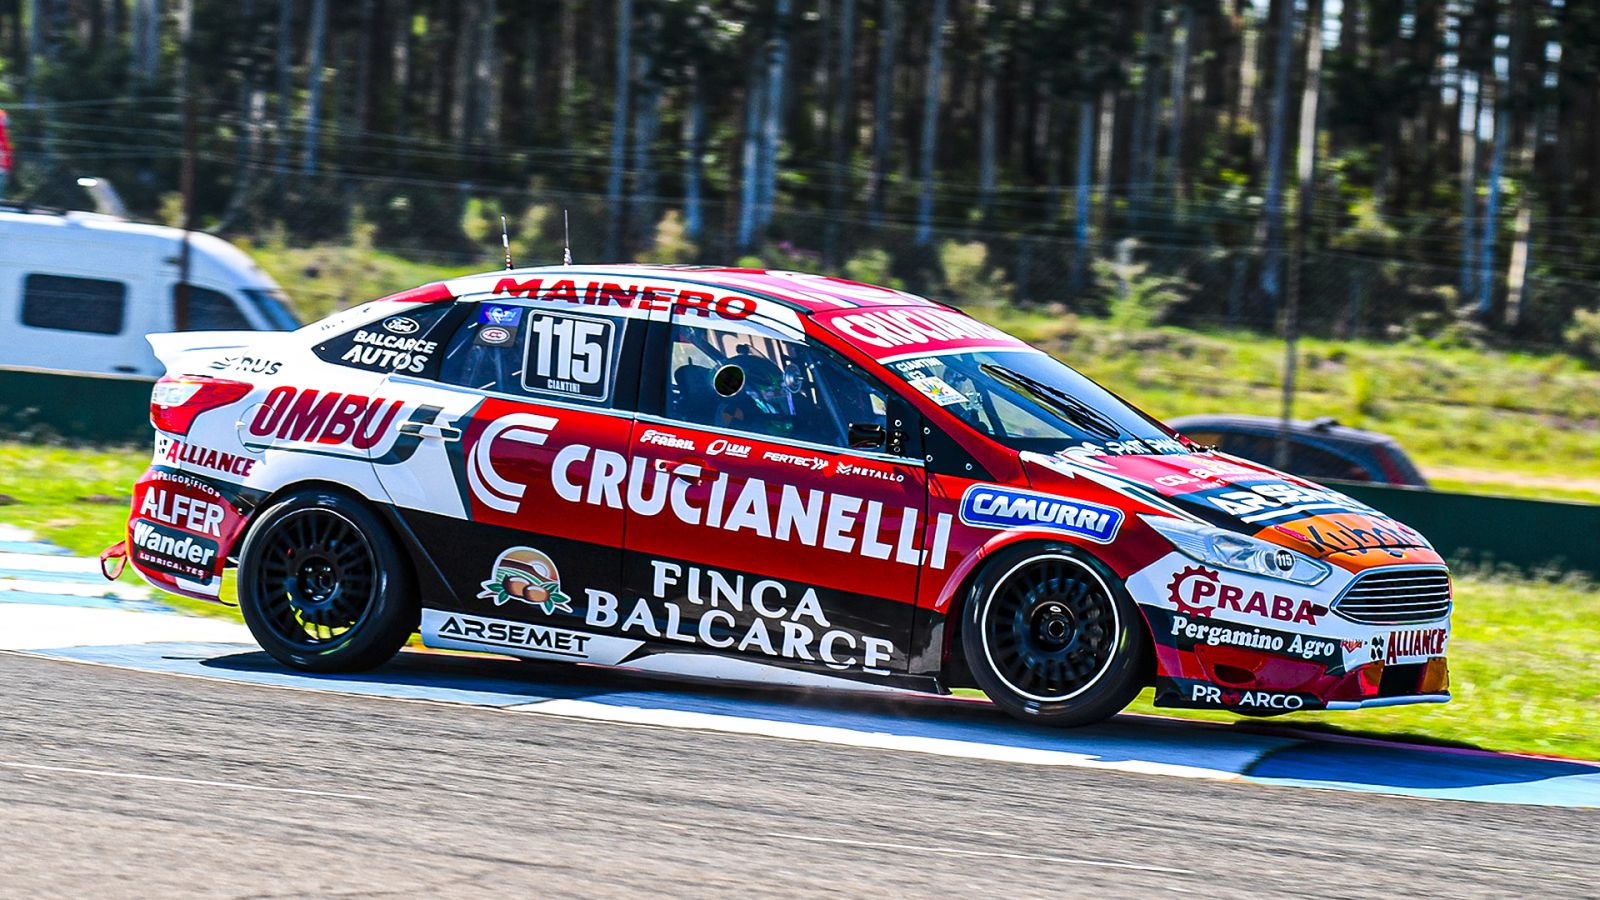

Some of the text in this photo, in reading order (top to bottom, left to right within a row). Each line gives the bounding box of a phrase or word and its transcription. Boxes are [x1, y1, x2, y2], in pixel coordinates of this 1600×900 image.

[492, 278, 757, 320] MAINERO
[341, 344, 429, 373] AUTOS
[353, 330, 438, 354] BALCARCE
[533, 316, 604, 384] 115
[249, 386, 405, 451] OMBU
[166, 439, 257, 477] ALLIANCE
[763, 451, 812, 467] FERTEC
[852, 467, 904, 482] METALLO
[140, 486, 225, 537] ALFER
[551, 444, 953, 570] CRUCIANELLI
[972, 493, 1111, 533] CAMURRI
[133, 521, 215, 566] Wander
[1276, 554, 1293, 567] 115
[139, 552, 205, 577] LUBRICATES
[650, 560, 831, 628] FINCA
[1191, 579, 1318, 626] PRABA
[439, 616, 592, 653] ARSEMET
[584, 587, 894, 676] BALCARCE
[1171, 616, 1335, 660] Pergamino Agro
[1386, 628, 1447, 665] ALLIANCE
